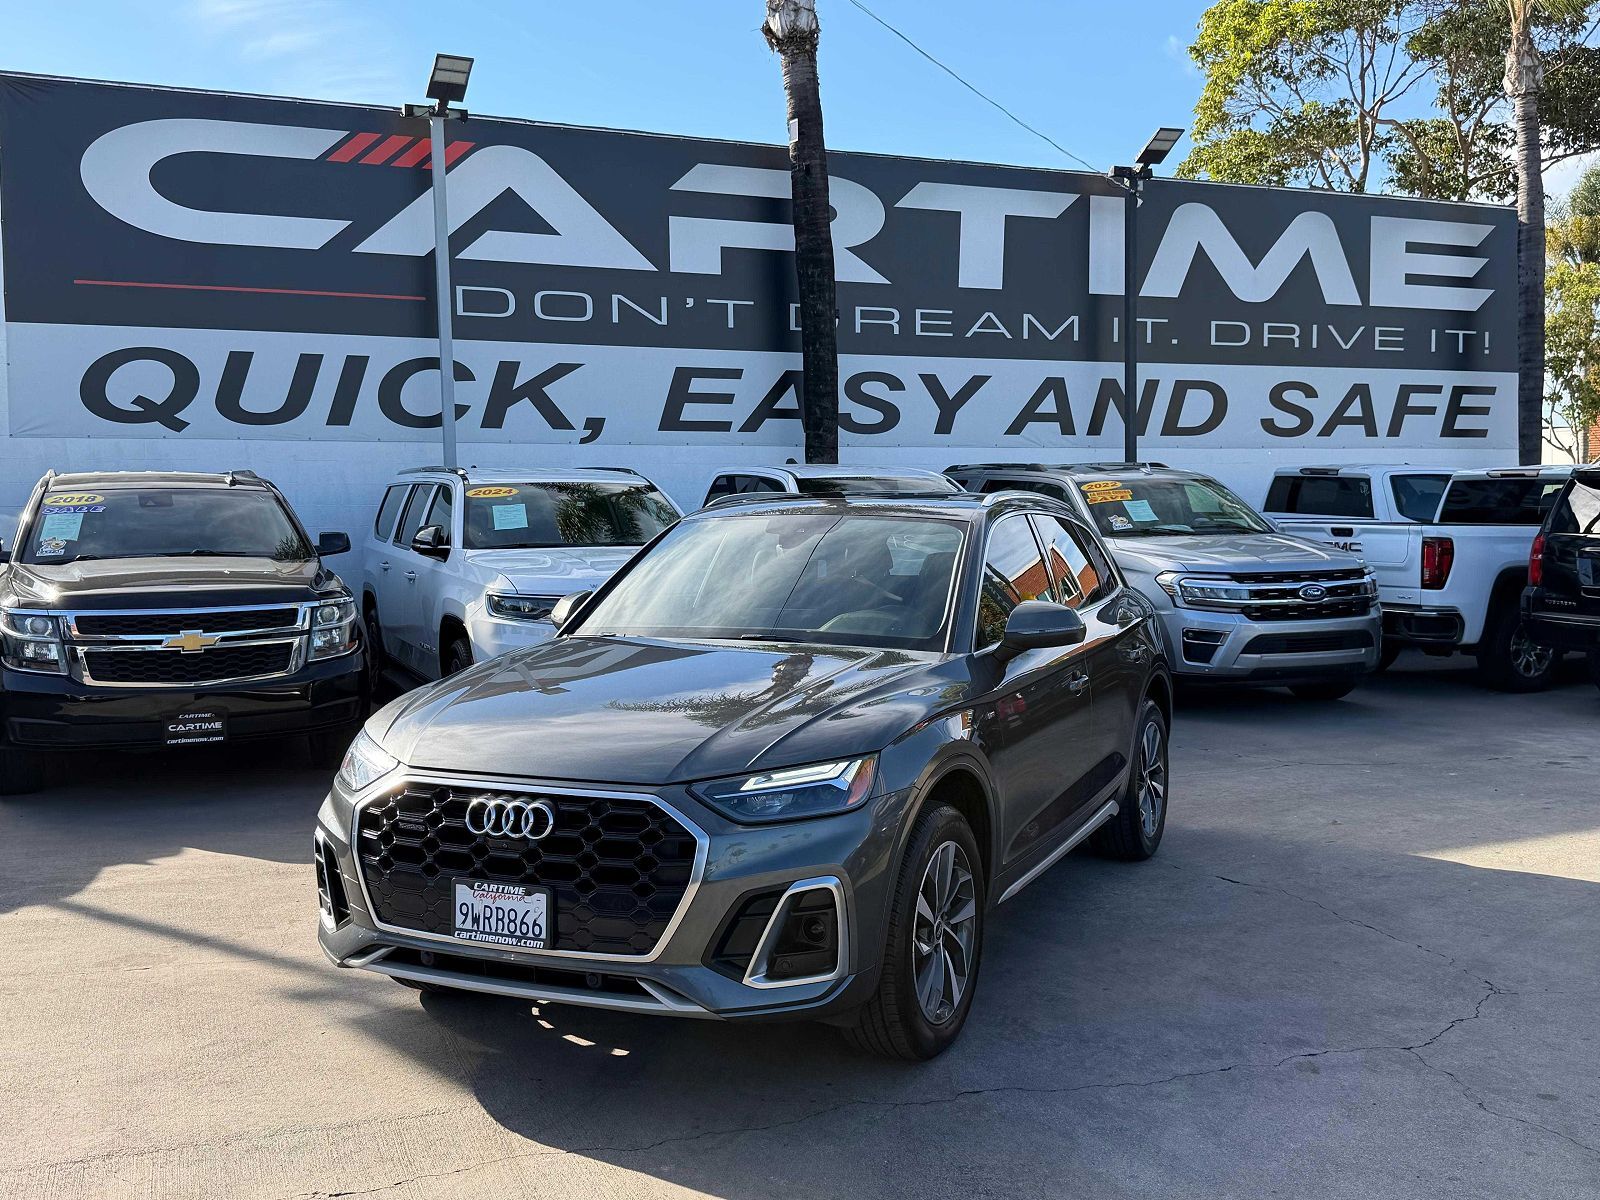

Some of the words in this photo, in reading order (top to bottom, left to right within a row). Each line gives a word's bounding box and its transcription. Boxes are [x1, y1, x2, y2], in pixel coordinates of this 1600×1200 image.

[80, 118, 1496, 311] CARTIME
[456, 286, 754, 328] DON'T
[1113, 317, 1178, 344] IT.
[1210, 320, 1405, 352] DRIVE
[1430, 328, 1491, 355] IT!
[80, 347, 606, 445] QUICK,
[658, 367, 992, 435] EASY
[1003, 376, 1228, 437] AND
[1260, 381, 1497, 438] SAFE
[1086, 481, 1118, 490] 2022
[471, 488, 513, 497] 2024
[50, 495, 98, 504] 2018
[42, 505, 106, 514] SALE
[1323, 541, 1363, 552] MC
[168, 721, 223, 732] CARTIME
[166, 736, 224, 744] cartimenow.com
[474, 882, 526, 895] CARTIME
[459, 902, 544, 938] 9WRB866
[454, 930, 545, 949] cartimenow.com
